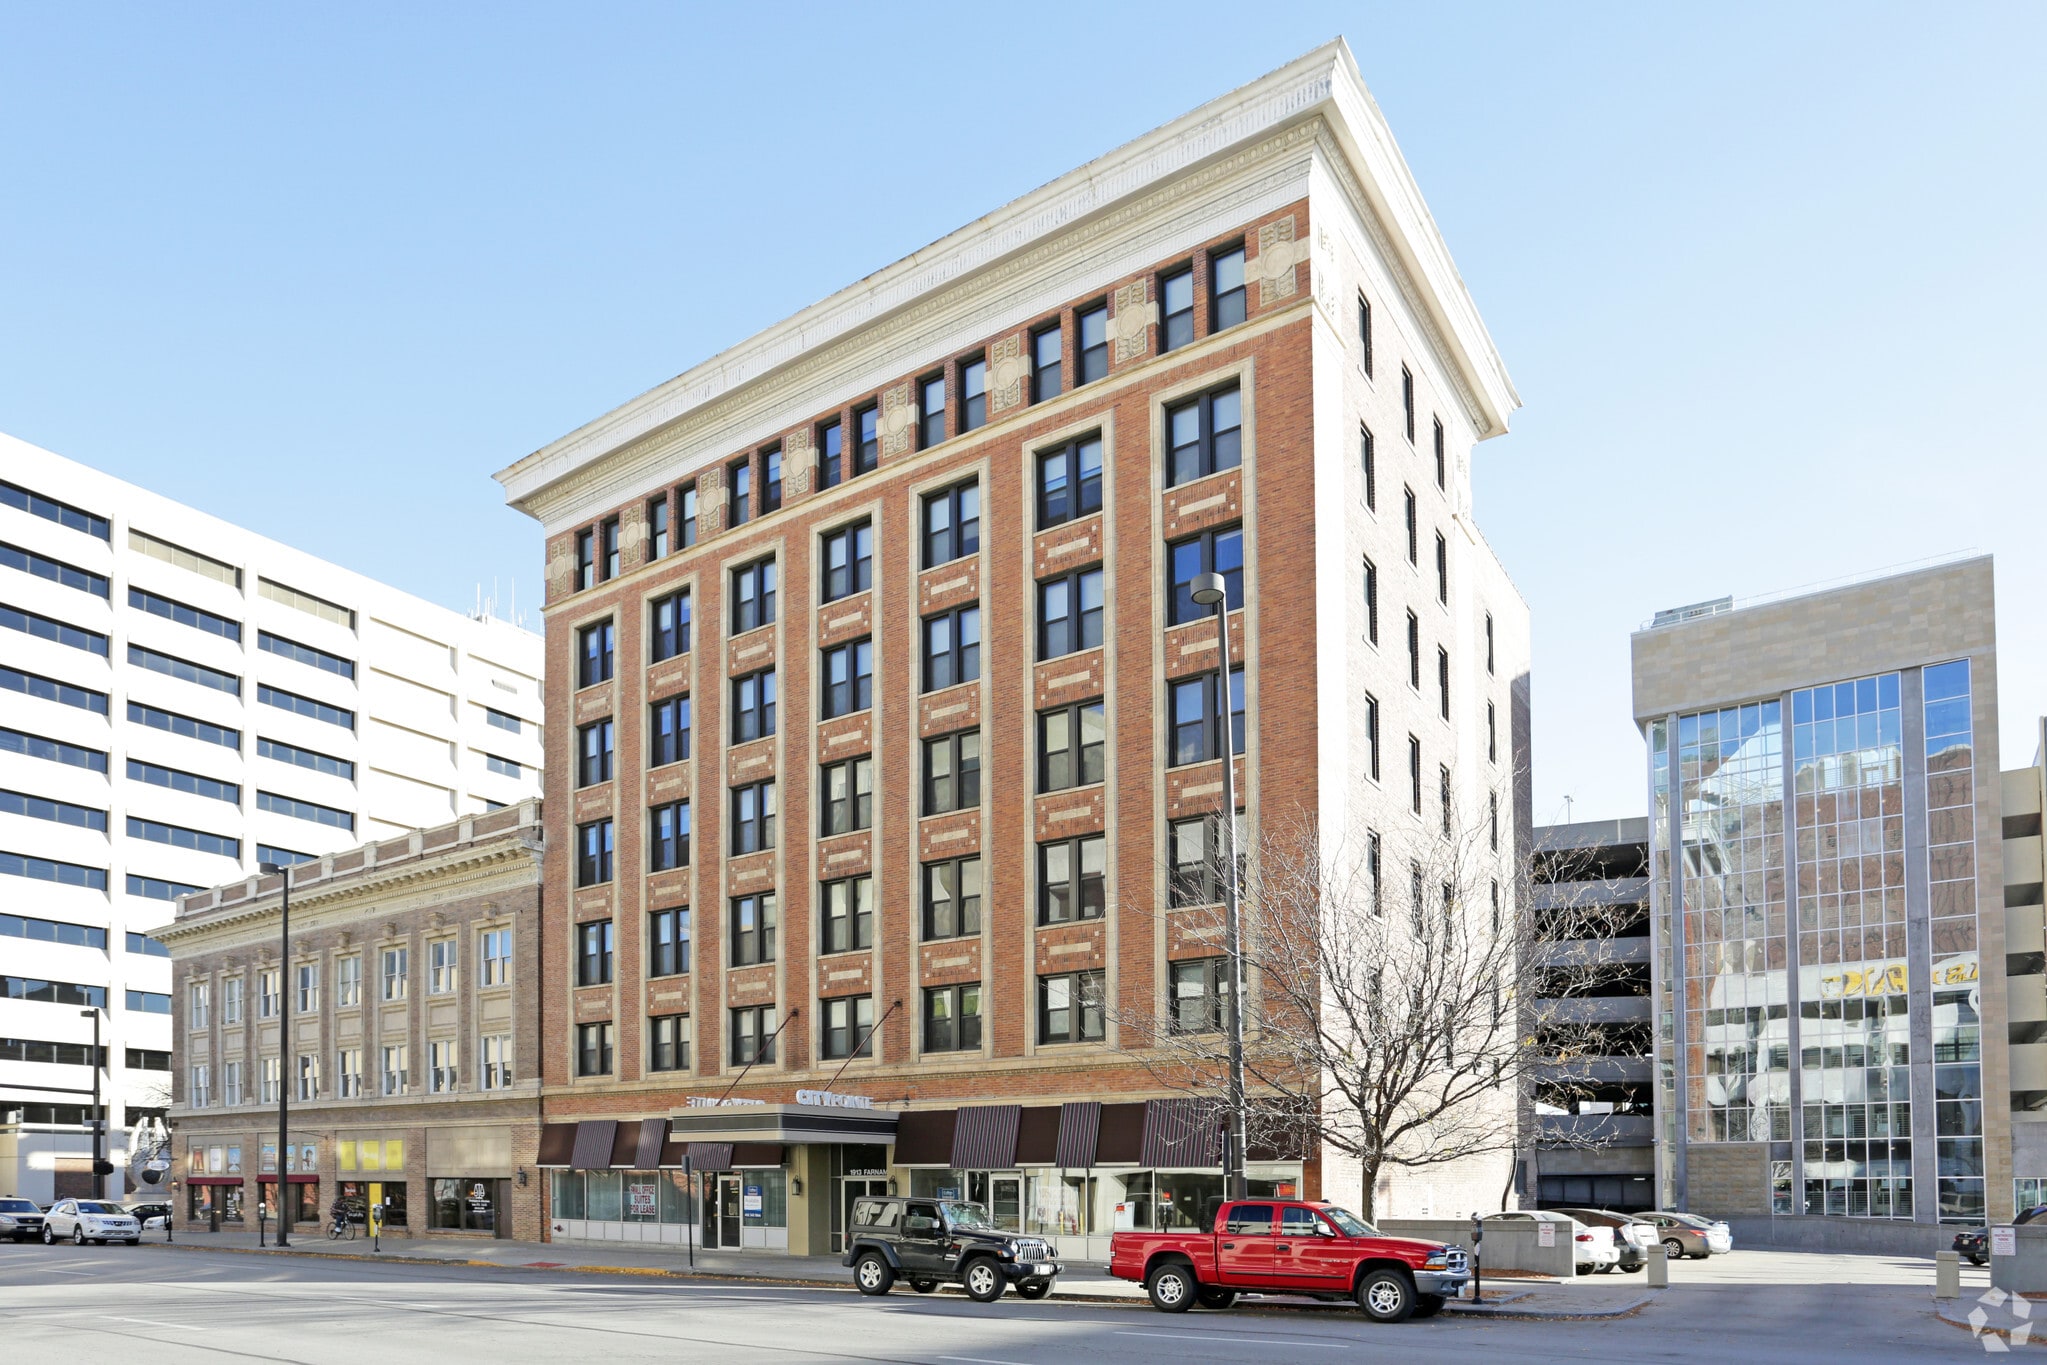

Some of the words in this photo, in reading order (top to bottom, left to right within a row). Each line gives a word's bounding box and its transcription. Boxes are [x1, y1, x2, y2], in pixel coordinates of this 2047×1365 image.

[863, 1168, 887, 1176] FARNAM
[634, 1195, 651, 1204] SUITES
[640, 1204, 655, 1214] LEASE
